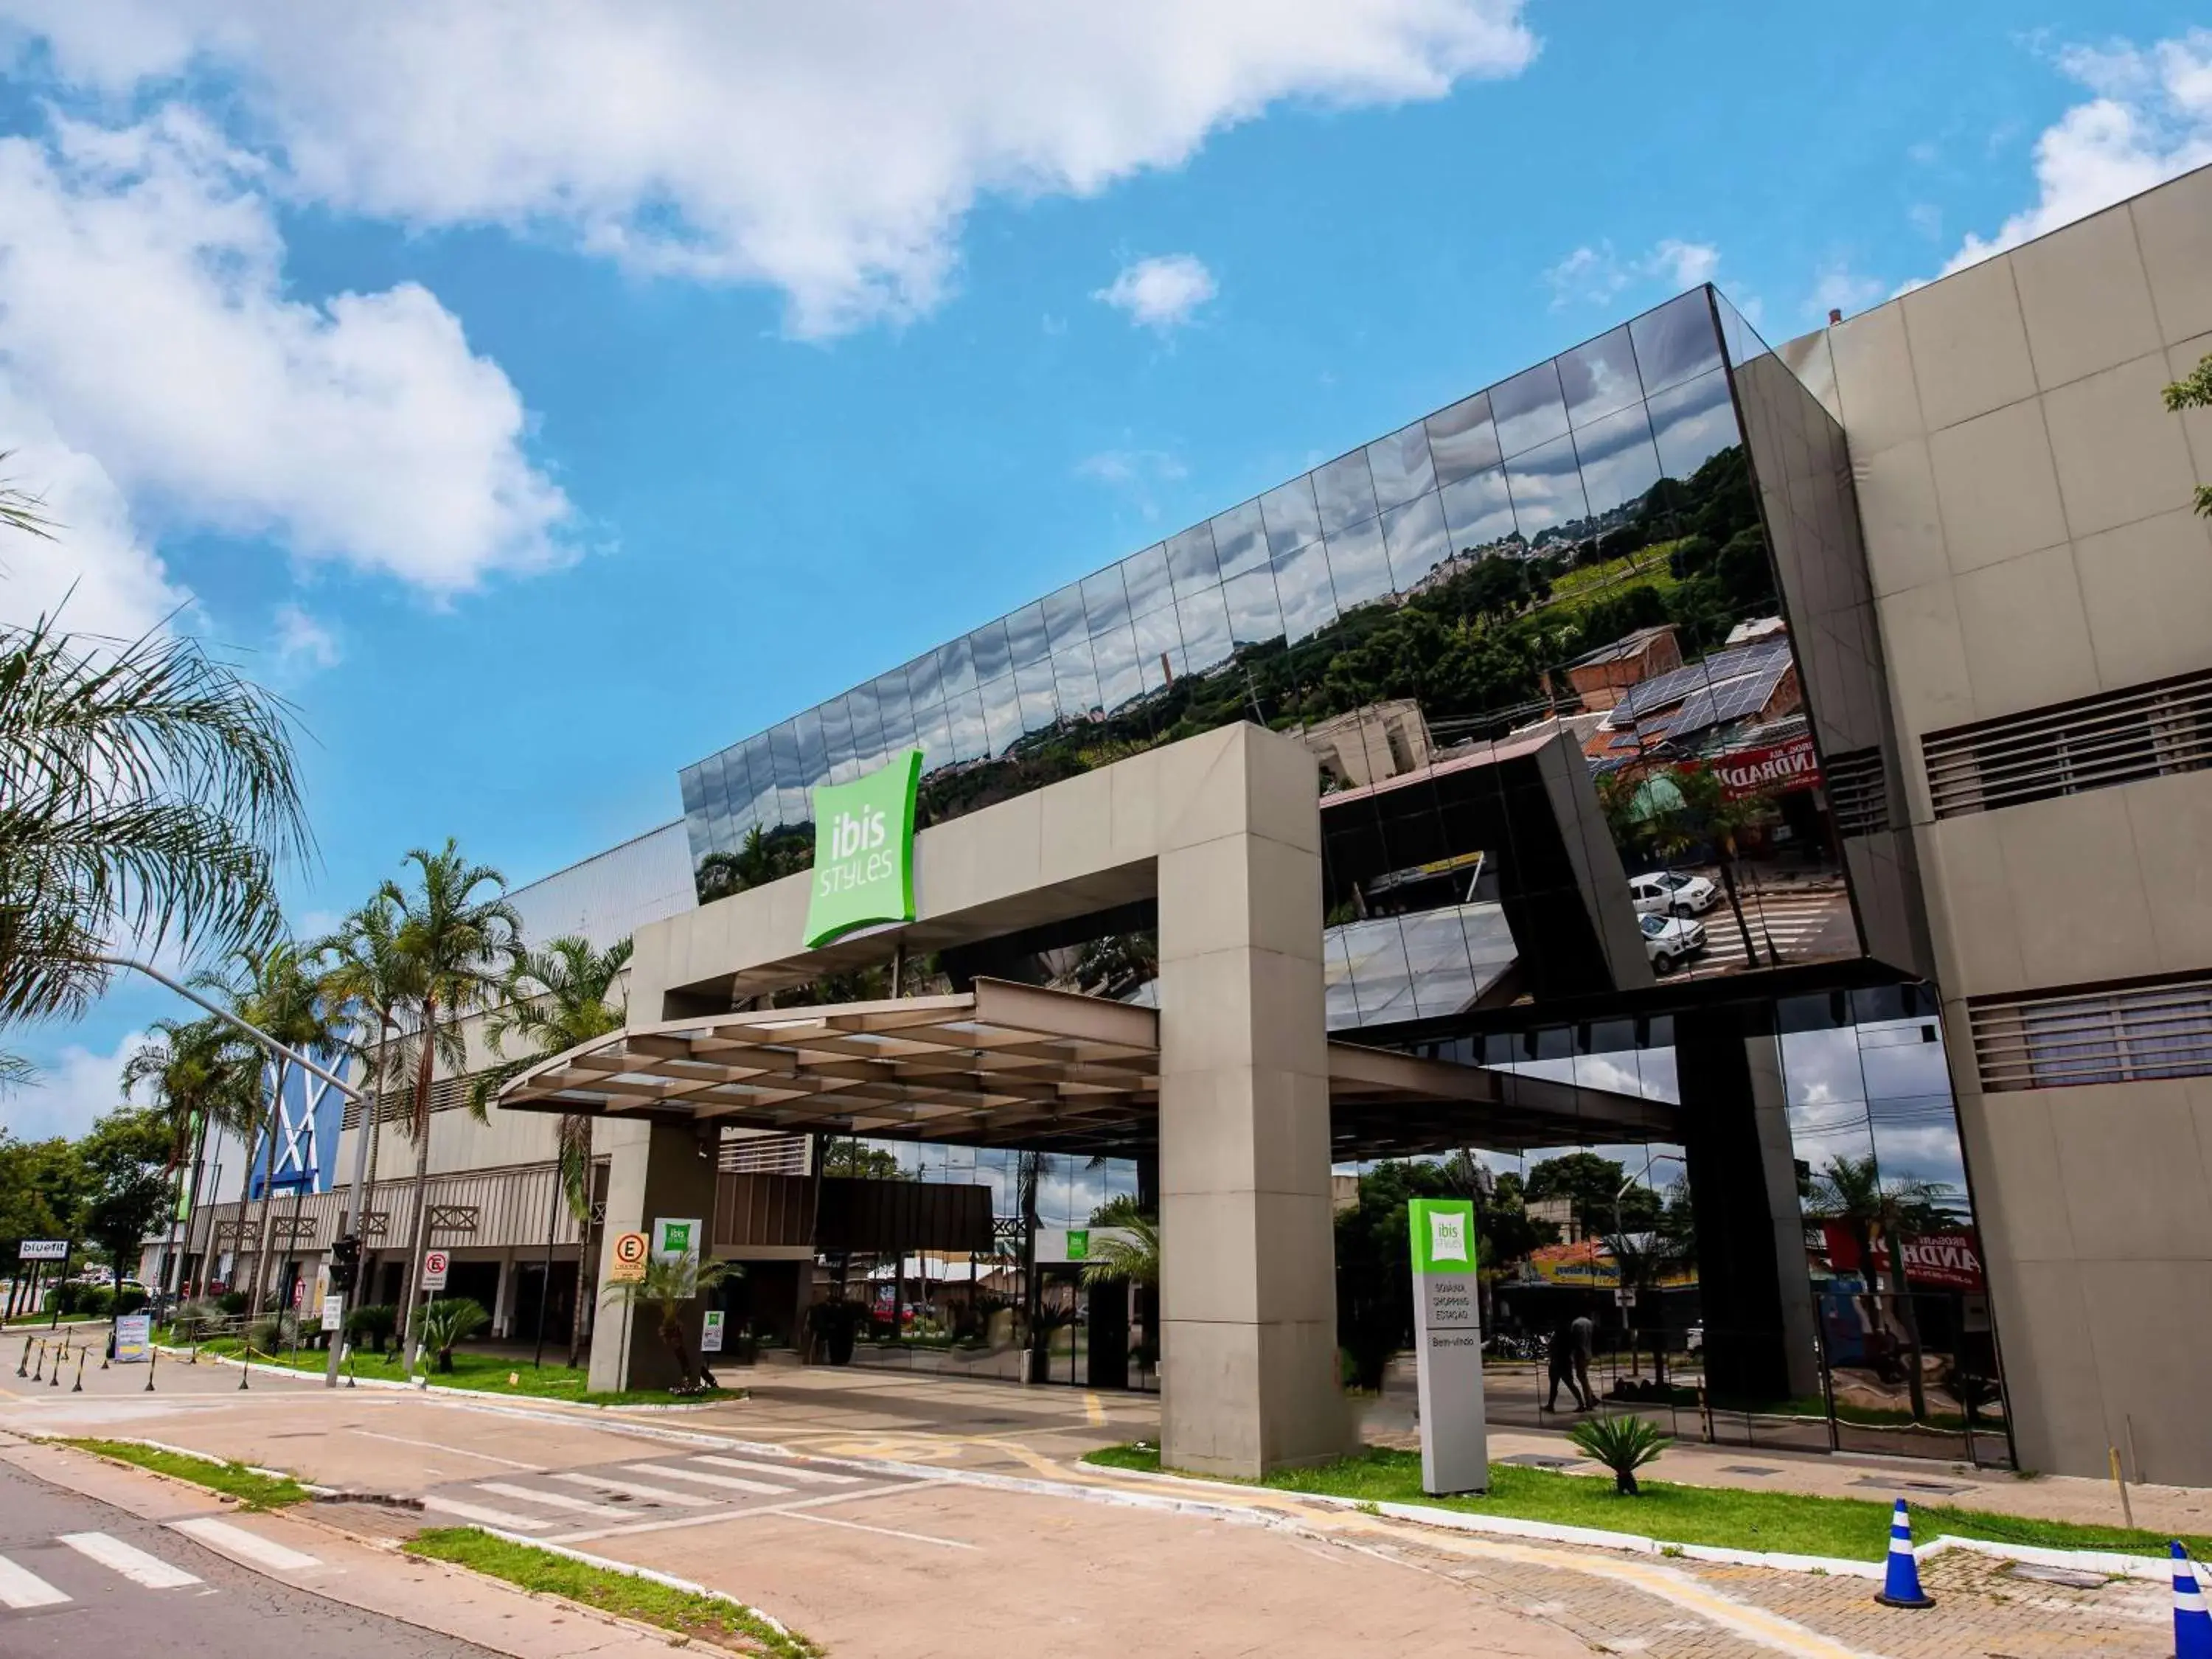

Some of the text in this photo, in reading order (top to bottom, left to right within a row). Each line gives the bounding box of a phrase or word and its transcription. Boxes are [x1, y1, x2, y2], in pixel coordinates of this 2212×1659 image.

[832, 804, 886, 861] ibis
[1439, 1222, 1458, 1238] ibis
[625, 1241, 636, 1257] E
[1433, 1337, 1474, 1347] Bem-vindo
